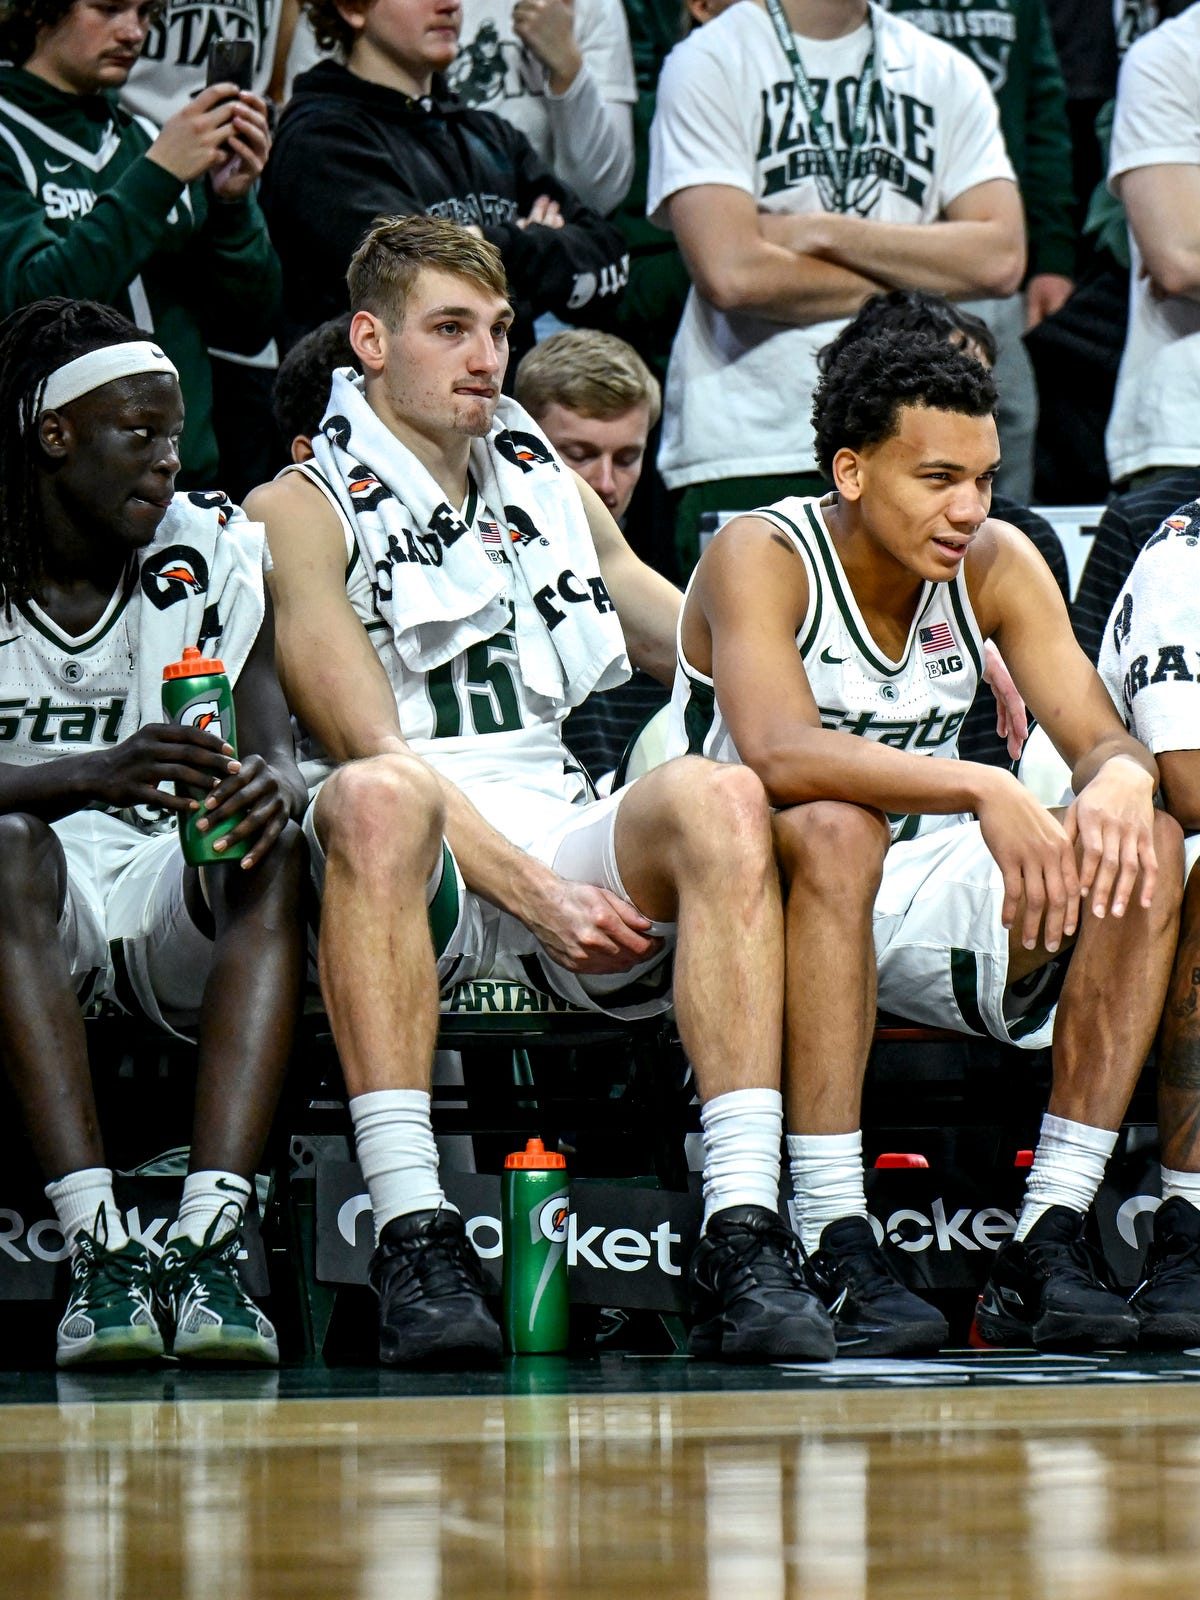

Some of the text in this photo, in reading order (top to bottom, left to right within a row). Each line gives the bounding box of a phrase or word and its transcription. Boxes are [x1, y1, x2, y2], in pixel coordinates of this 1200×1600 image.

[424, 633, 526, 739] 15
[0, 696, 129, 744] Stat
[465, 1211, 682, 1276] oket
